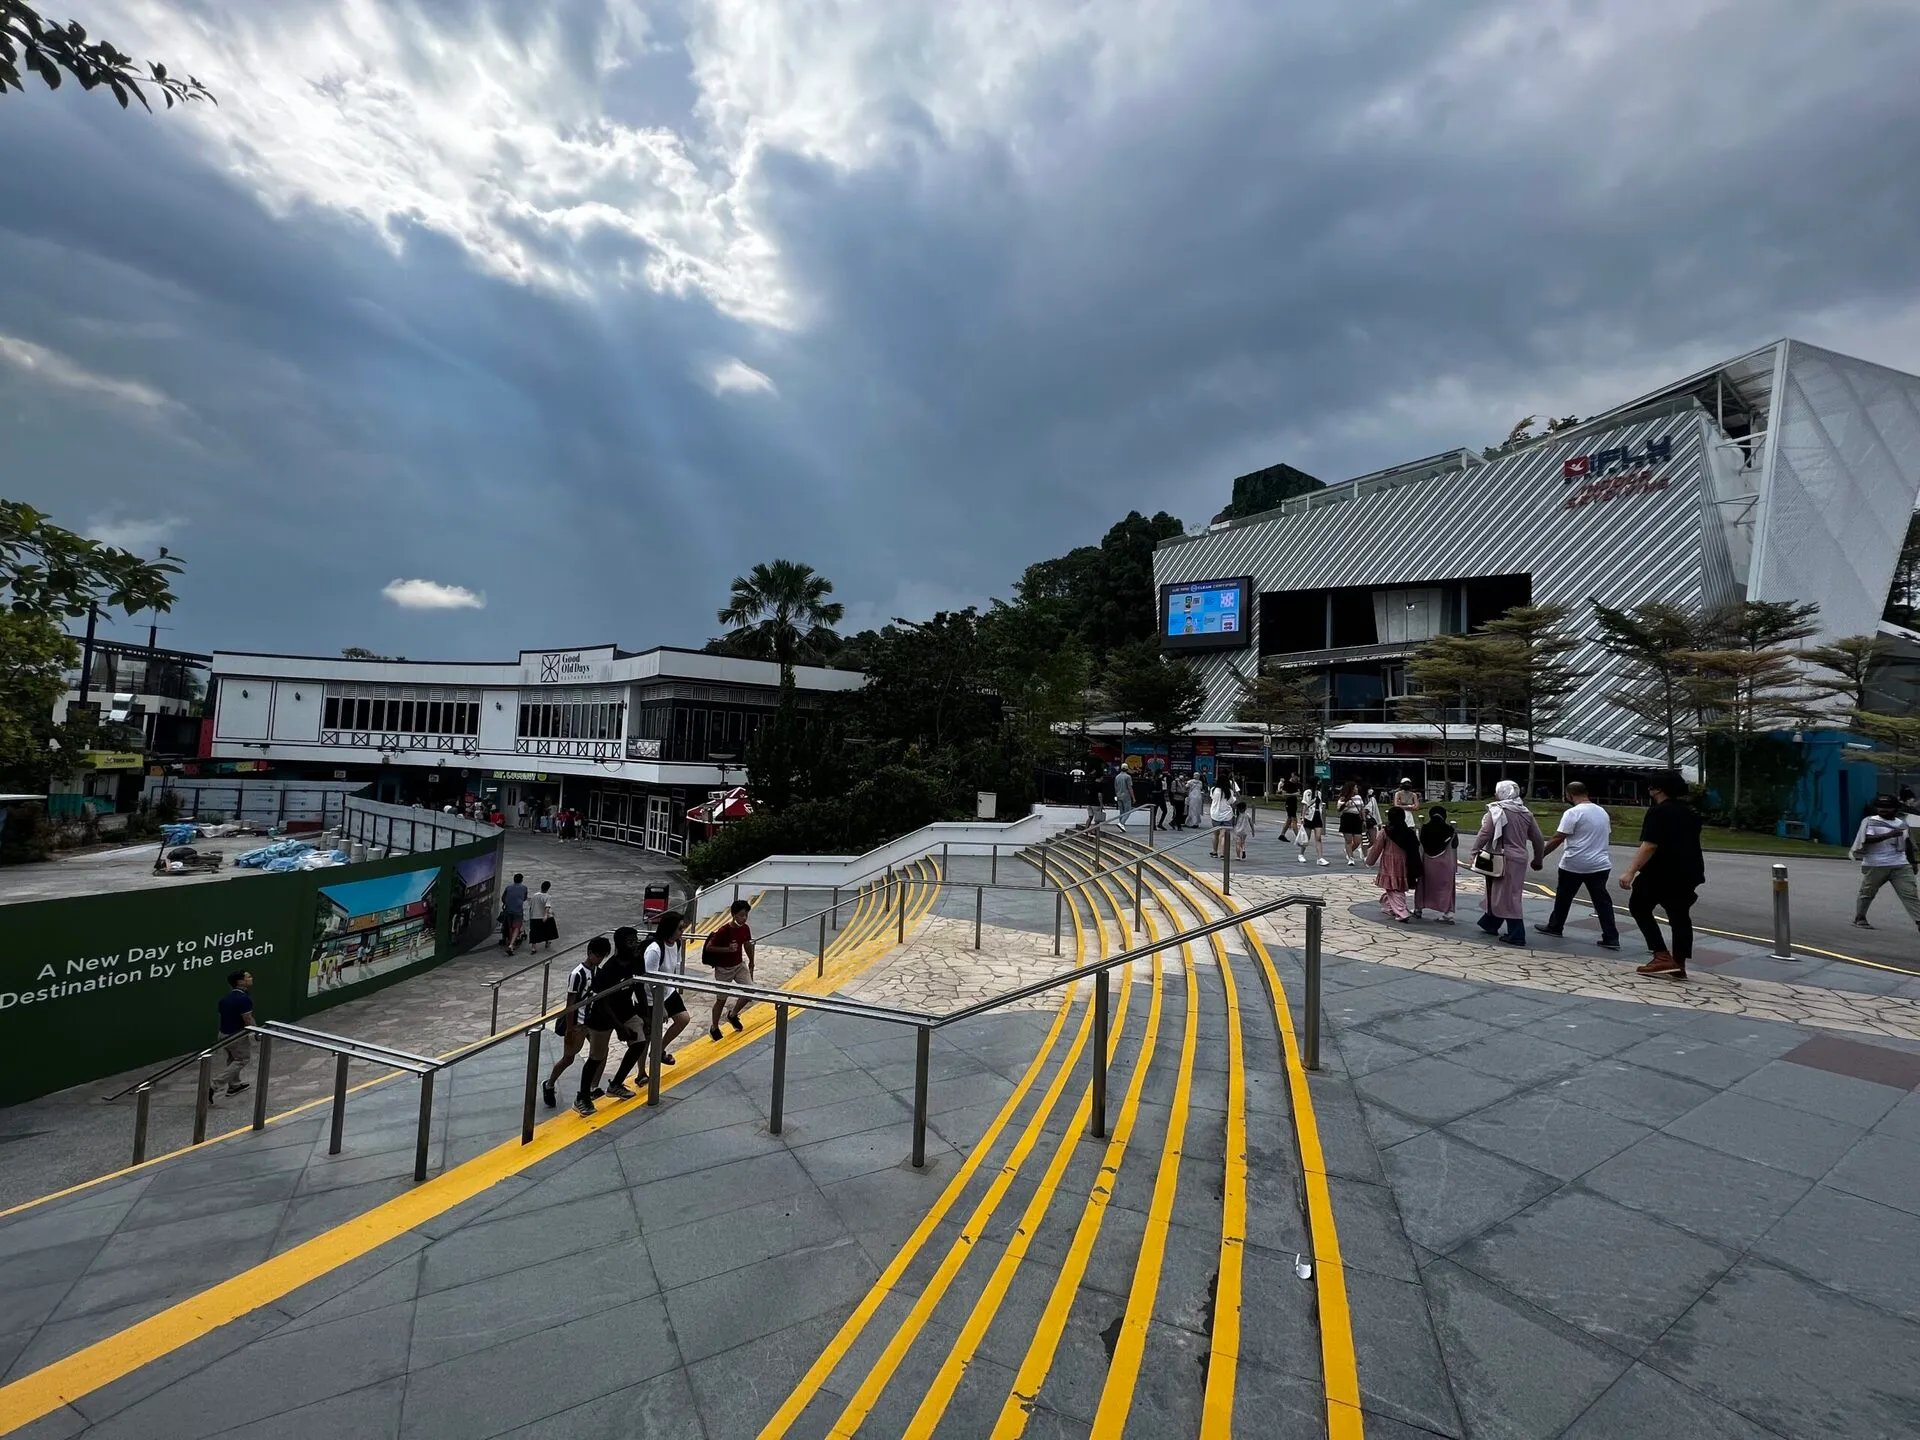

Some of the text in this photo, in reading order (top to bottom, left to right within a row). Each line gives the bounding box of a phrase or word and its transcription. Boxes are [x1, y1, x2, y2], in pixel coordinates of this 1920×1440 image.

[562, 652, 580, 663] Good
[0, 941, 274, 1010] Destination by the Beach
[37, 928, 254, 980] A New Day to Night
